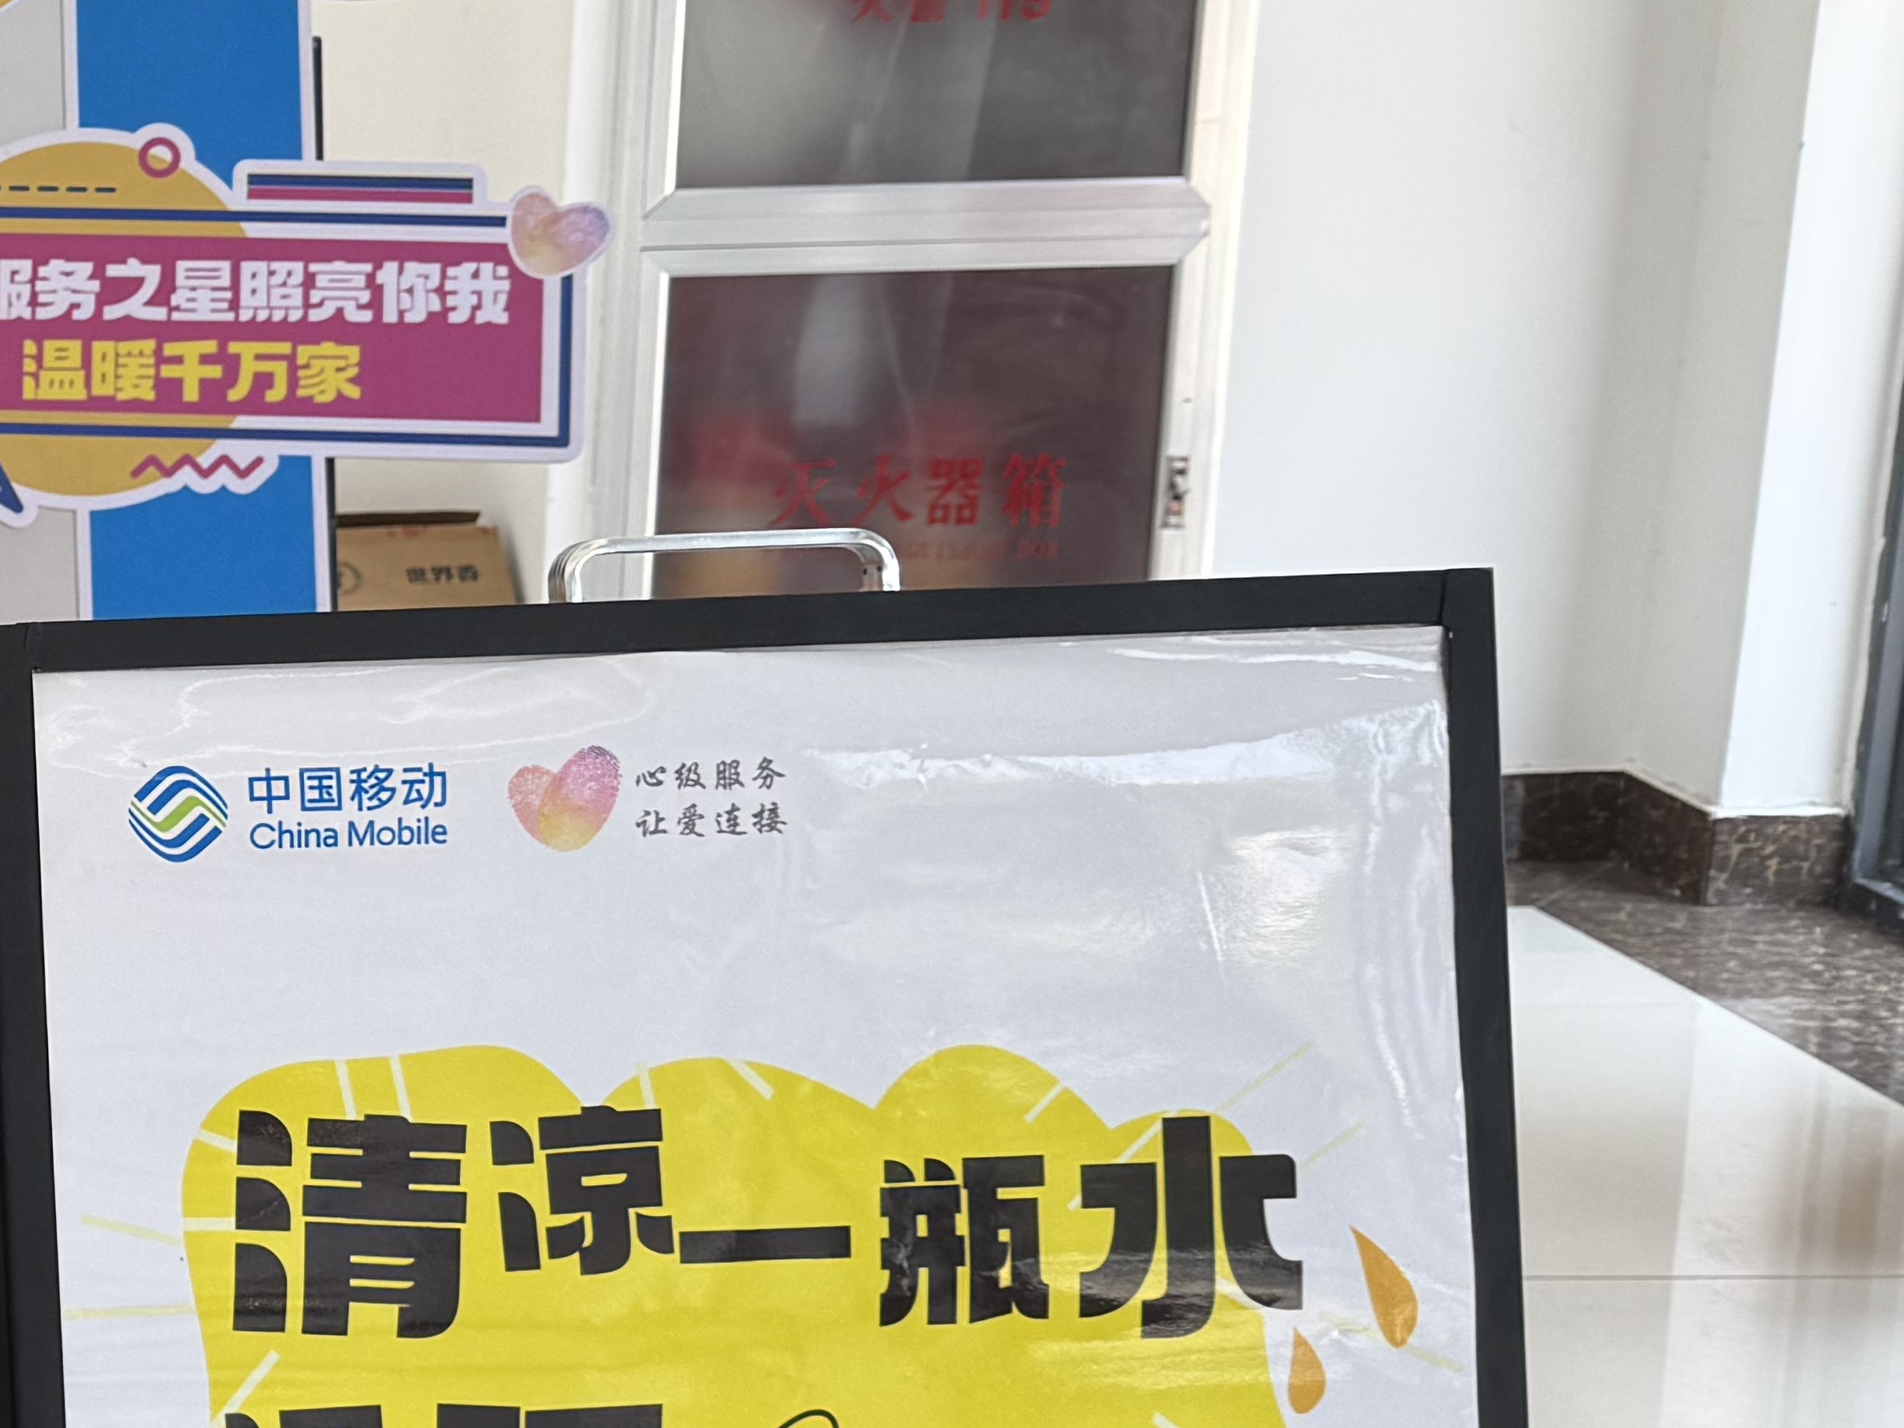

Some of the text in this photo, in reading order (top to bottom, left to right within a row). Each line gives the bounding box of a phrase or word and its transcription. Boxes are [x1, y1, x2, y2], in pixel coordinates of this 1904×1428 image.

[22, 337, 362, 403] 温暖千万家
[769, 453, 1067, 528] 灭火器箱
[248, 762, 448, 815] 中国移动
[635, 758, 786, 791] 心级服务
[250, 818, 448, 850] China Mobile
[635, 803, 788, 838] 让爱连接
[233, 1106, 1304, 1340] 清凉一瓶水
